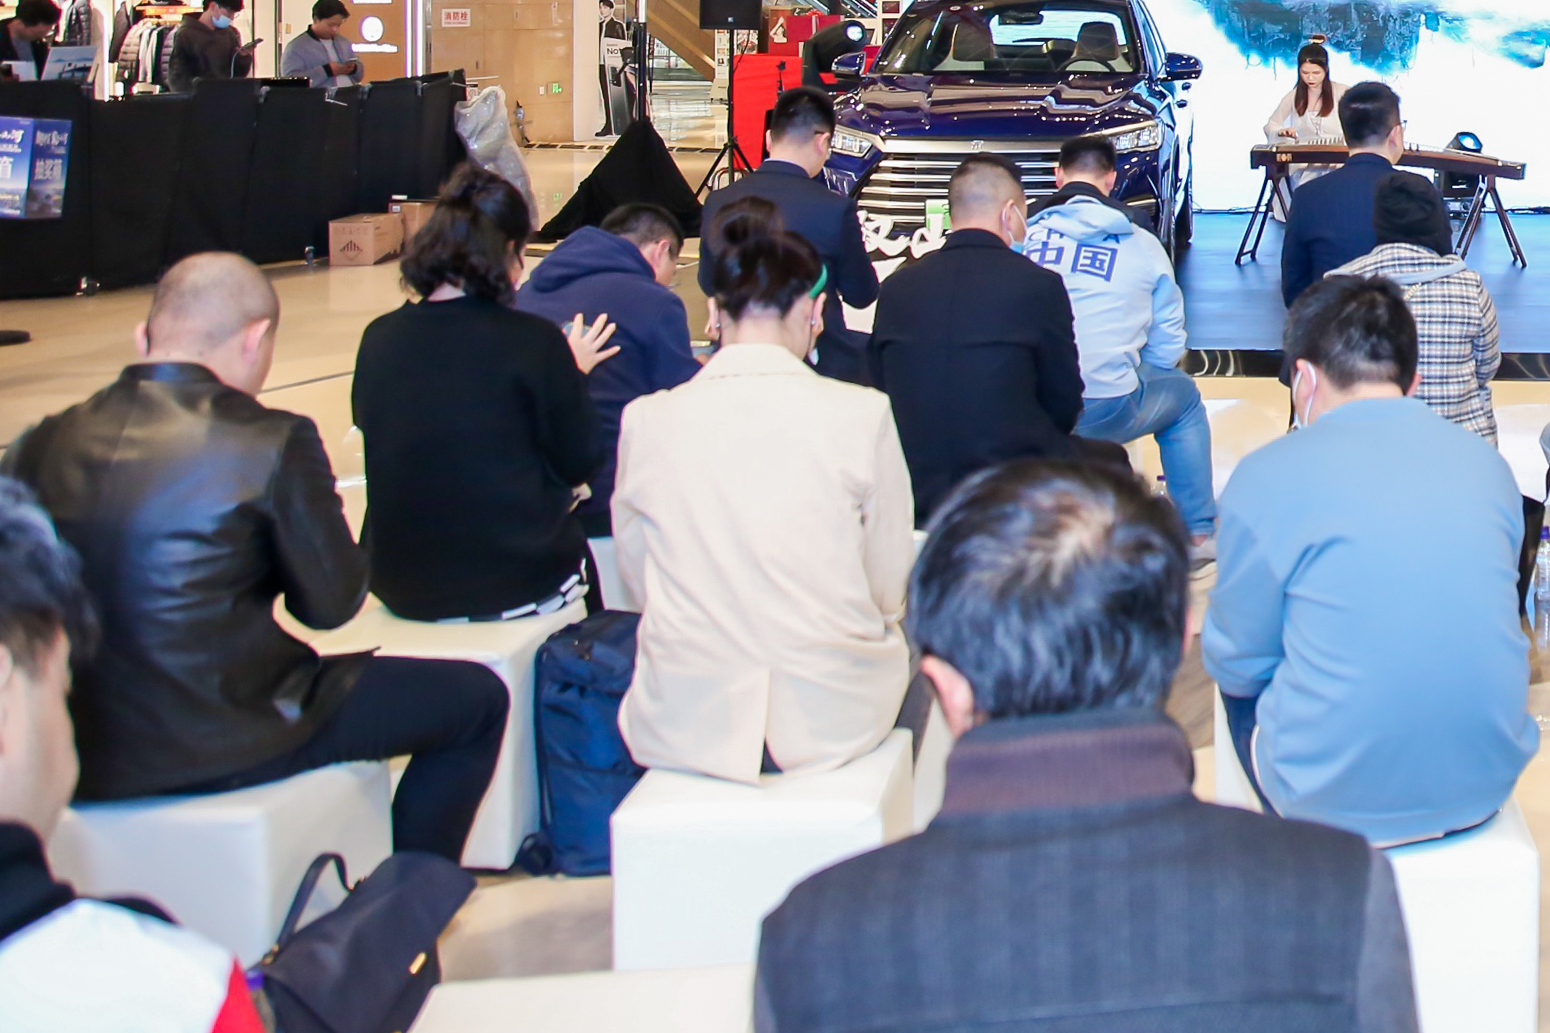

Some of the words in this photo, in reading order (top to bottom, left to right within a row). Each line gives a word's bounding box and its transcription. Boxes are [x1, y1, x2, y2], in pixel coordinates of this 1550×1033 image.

[444, 11, 468, 21] 消防栓
[1026, 227, 1121, 244] CHA
[1024, 241, 1120, 283] 中国
